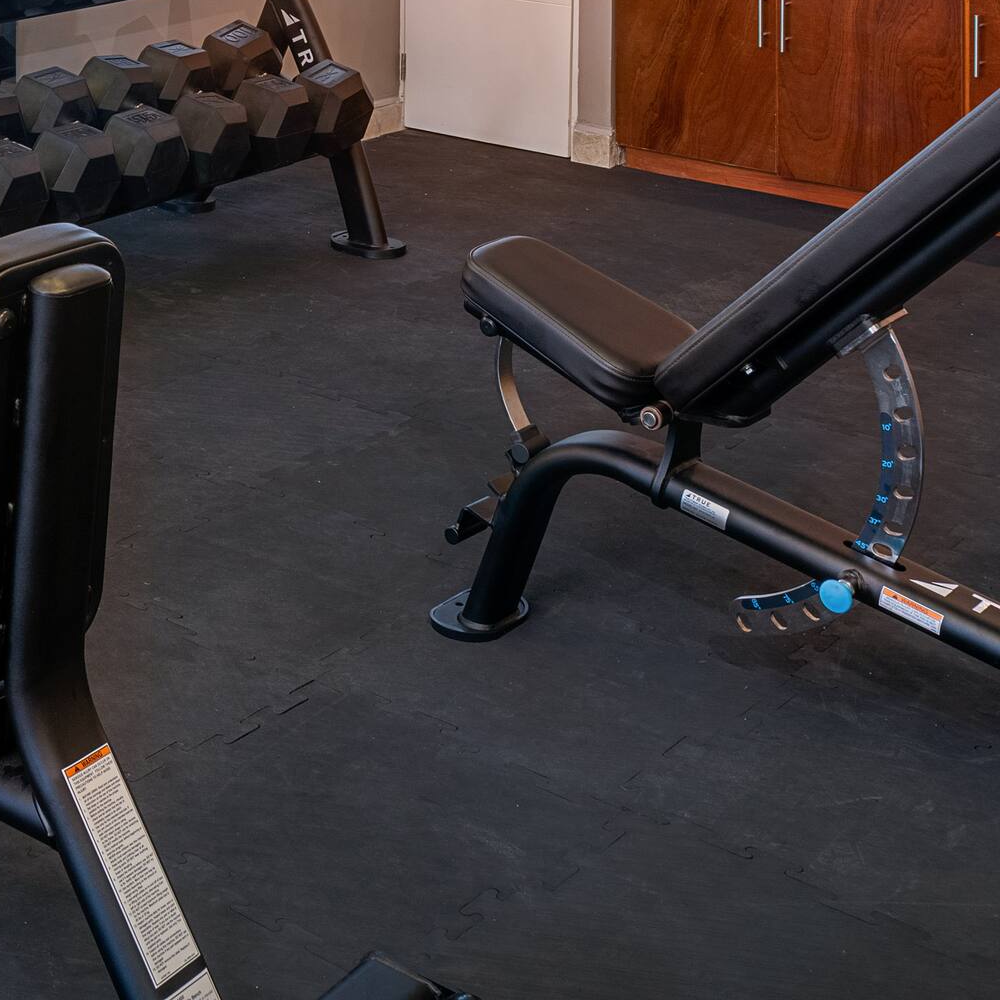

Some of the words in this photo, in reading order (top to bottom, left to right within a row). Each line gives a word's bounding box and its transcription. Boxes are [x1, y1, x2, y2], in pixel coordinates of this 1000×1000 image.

[291, 29, 315, 67] TR
[691, 493, 712, 508] TRUE
[81, 750, 103, 768] WARNING
